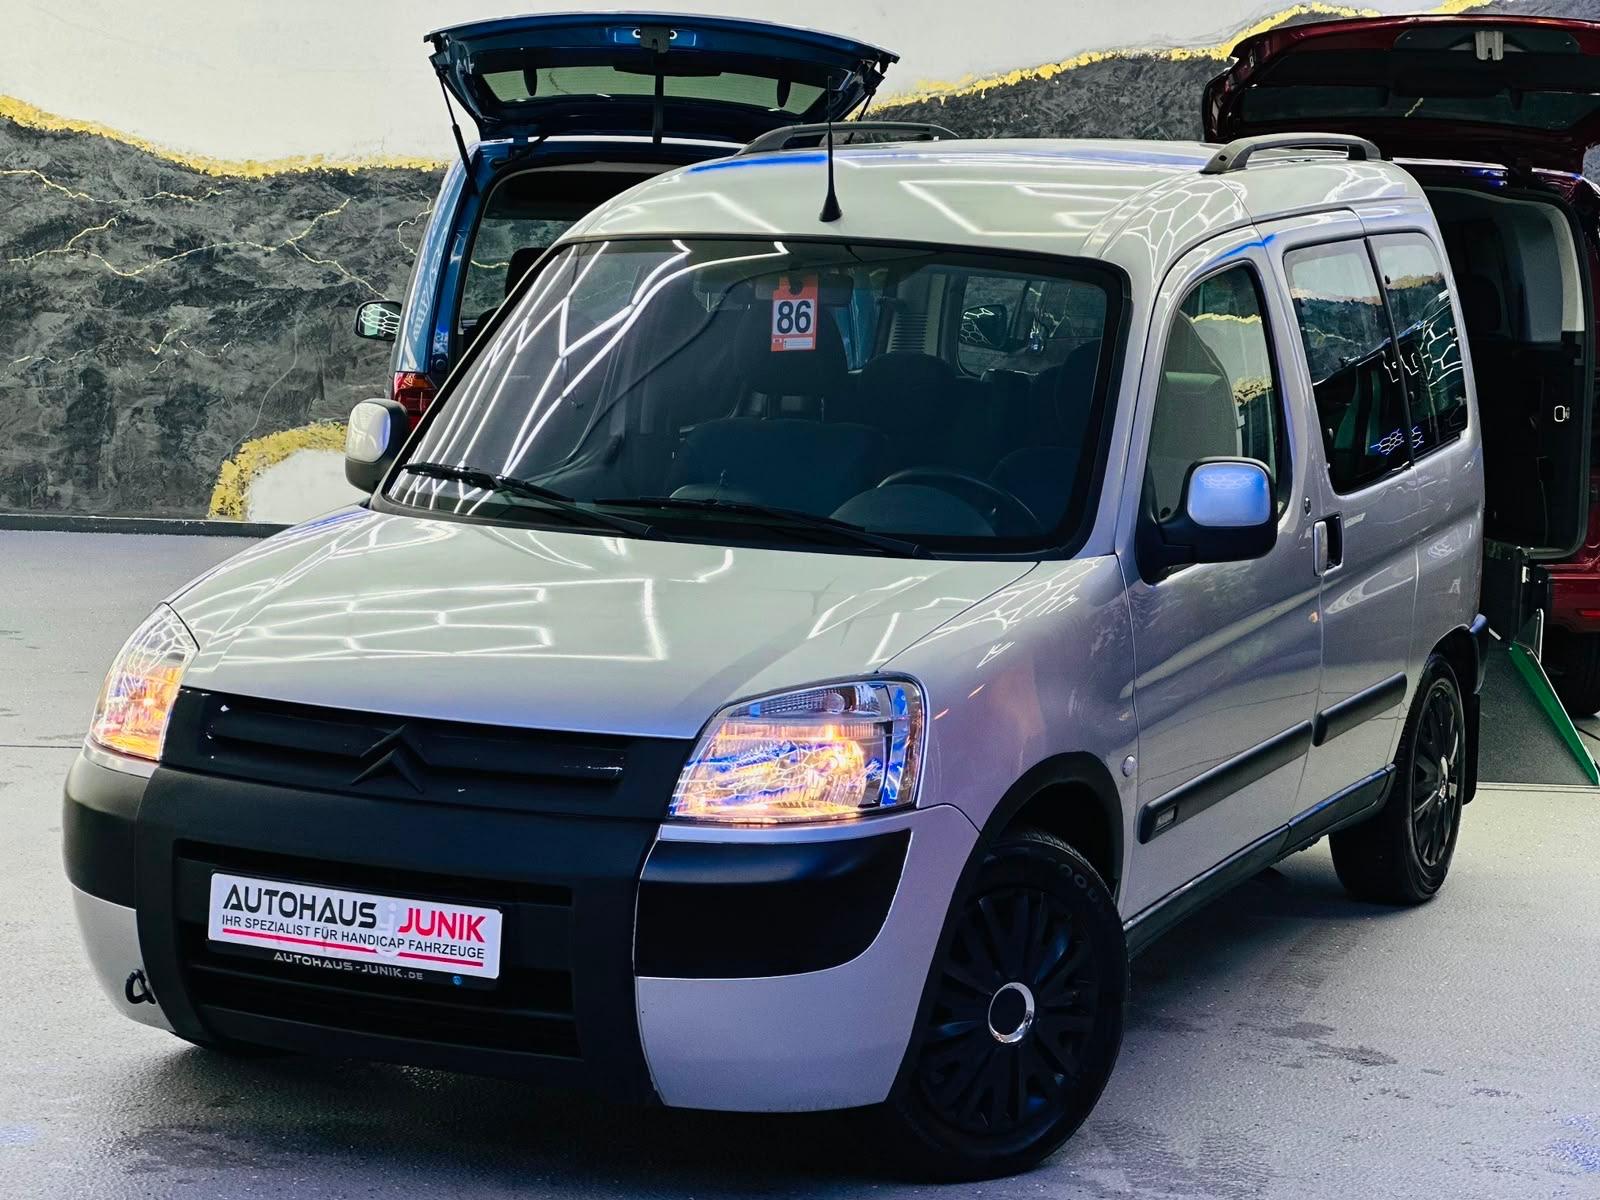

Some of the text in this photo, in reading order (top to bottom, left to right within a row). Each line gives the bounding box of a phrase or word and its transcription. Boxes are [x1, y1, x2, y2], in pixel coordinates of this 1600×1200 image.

[777, 300, 812, 334] 86
[223, 884, 377, 929] AUTOHAUS
[398, 907, 486, 943] JUNIK
[222, 914, 485, 959] IHR SPEZIALIST FÜR HANDICAP FAHRZEUGE
